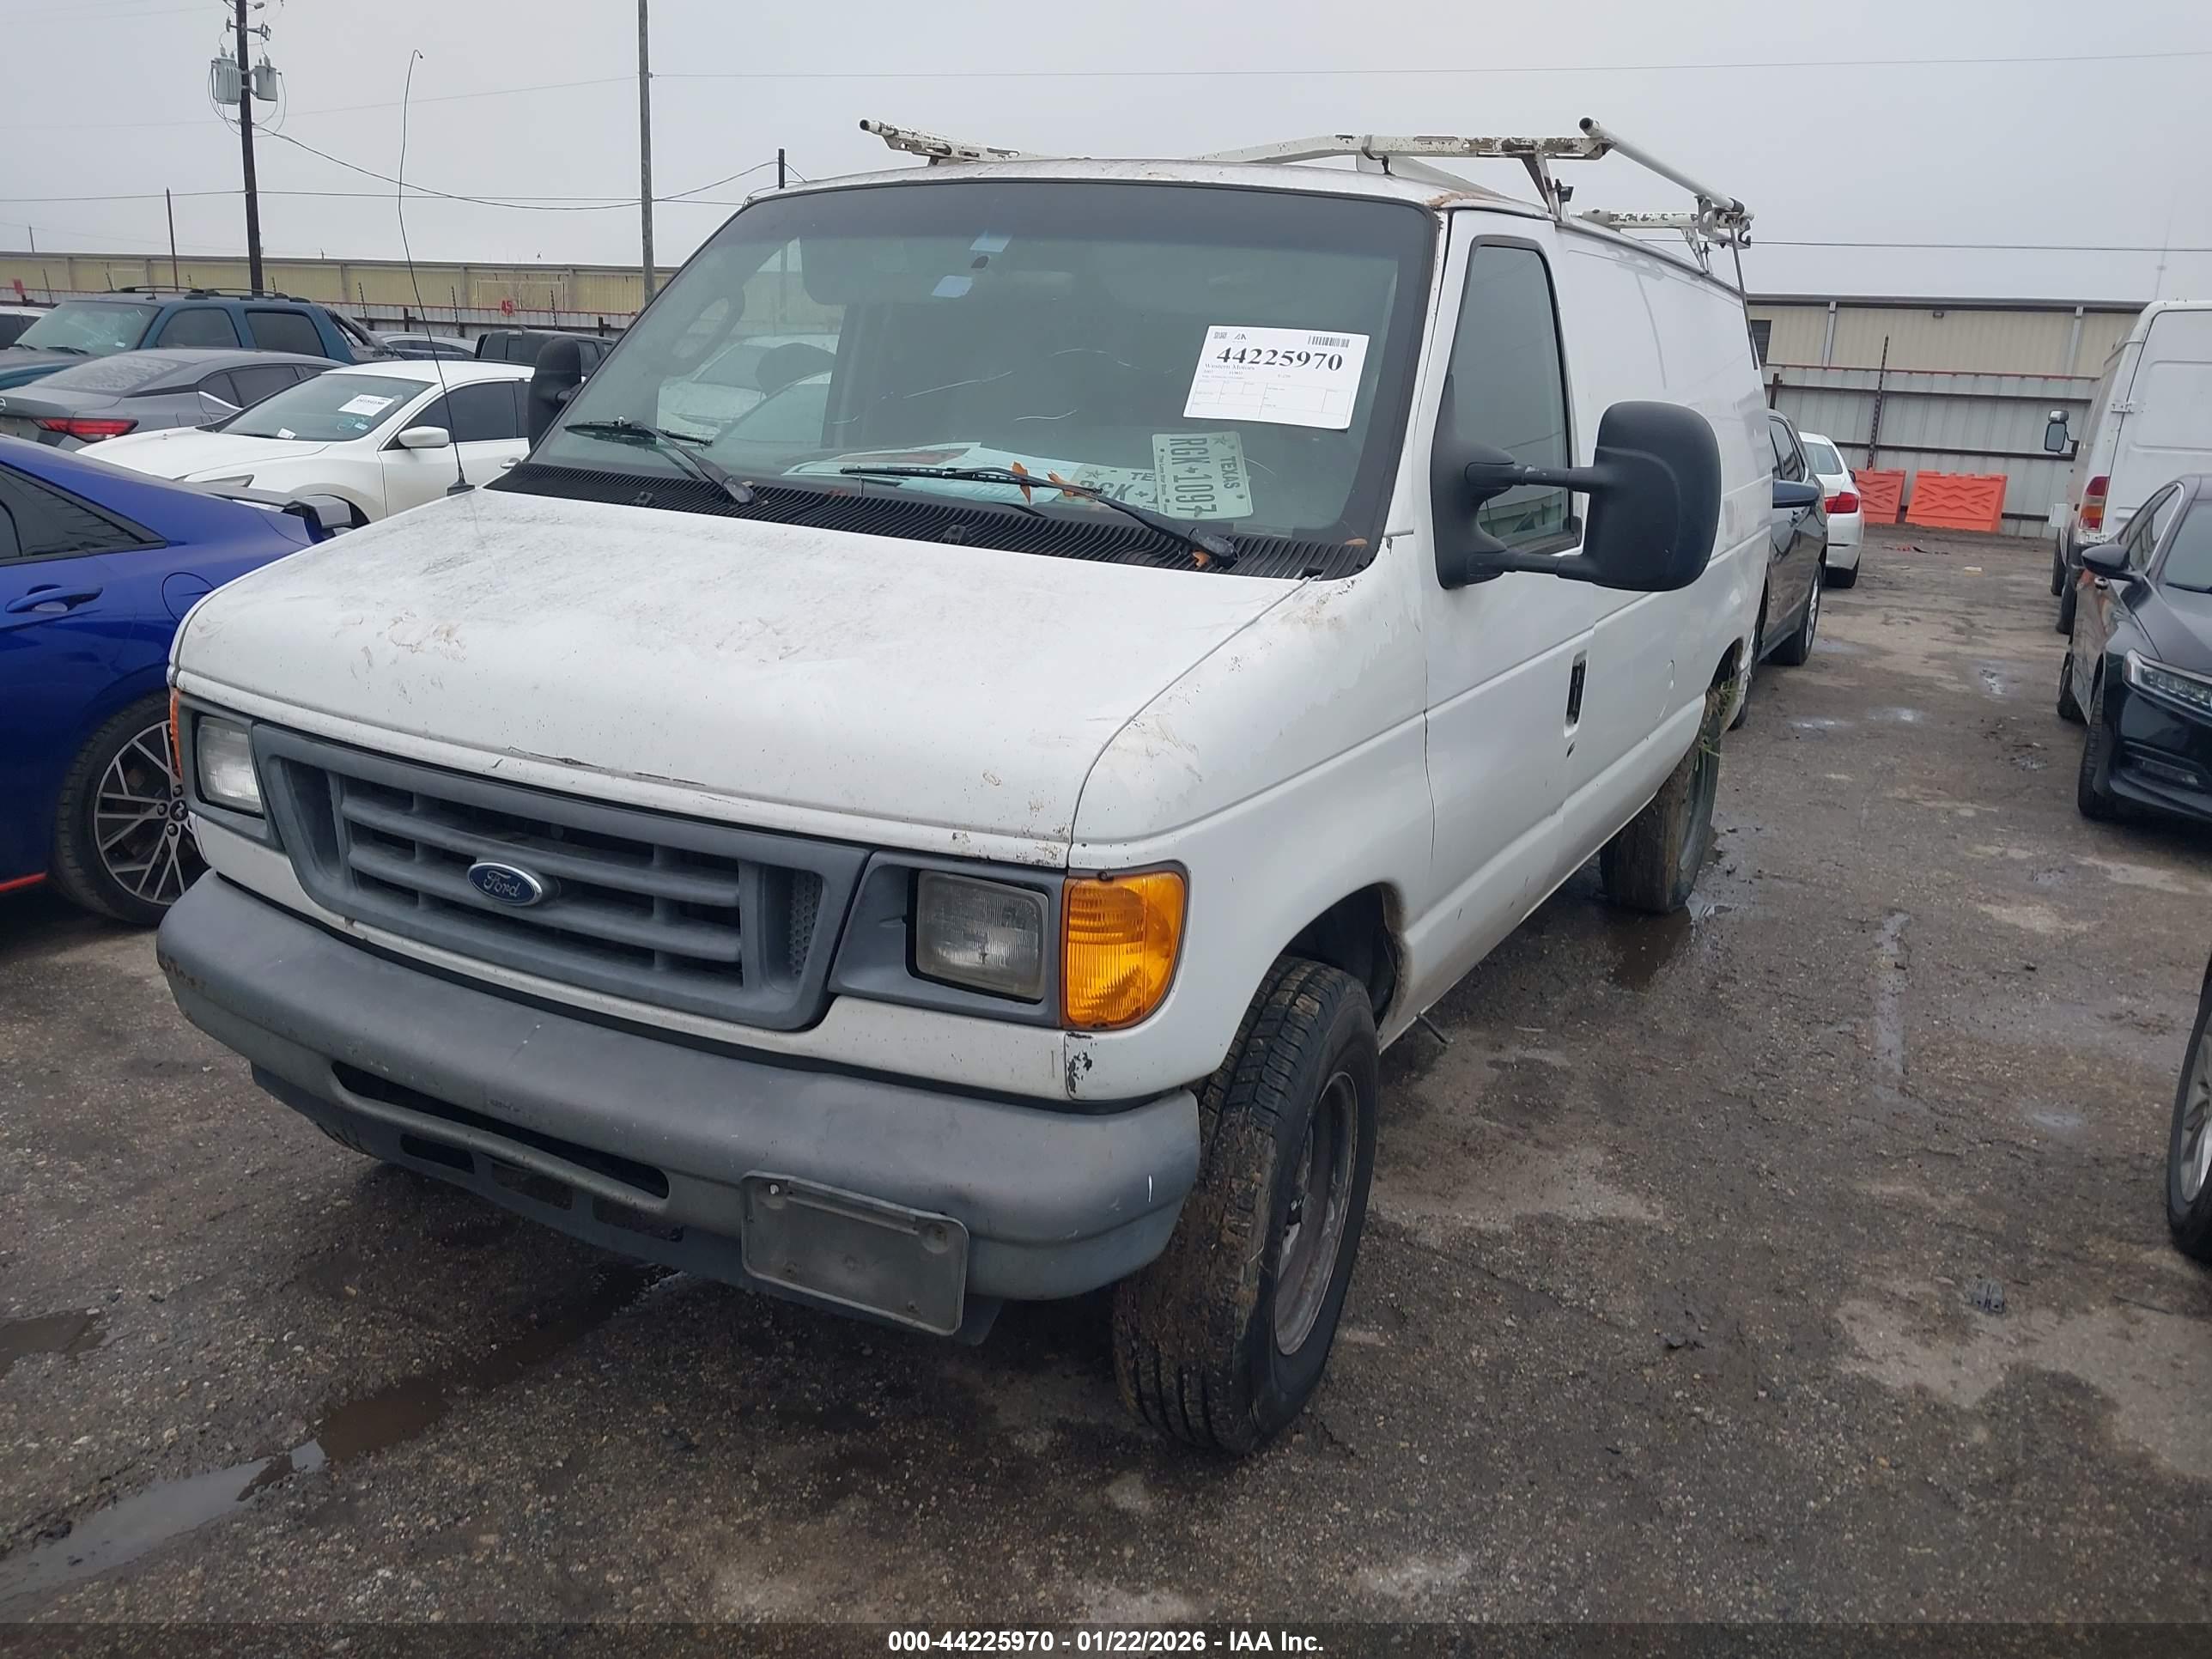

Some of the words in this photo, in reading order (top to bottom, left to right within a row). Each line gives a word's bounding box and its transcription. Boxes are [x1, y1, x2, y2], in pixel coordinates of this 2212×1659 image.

[1217, 346, 1343, 371] 44225970
[1170, 437, 1211, 465] RGK
[1220, 456, 1241, 489] TEXAS
[1173, 474, 1217, 513] 1097
[483, 870, 521, 897] Ford
